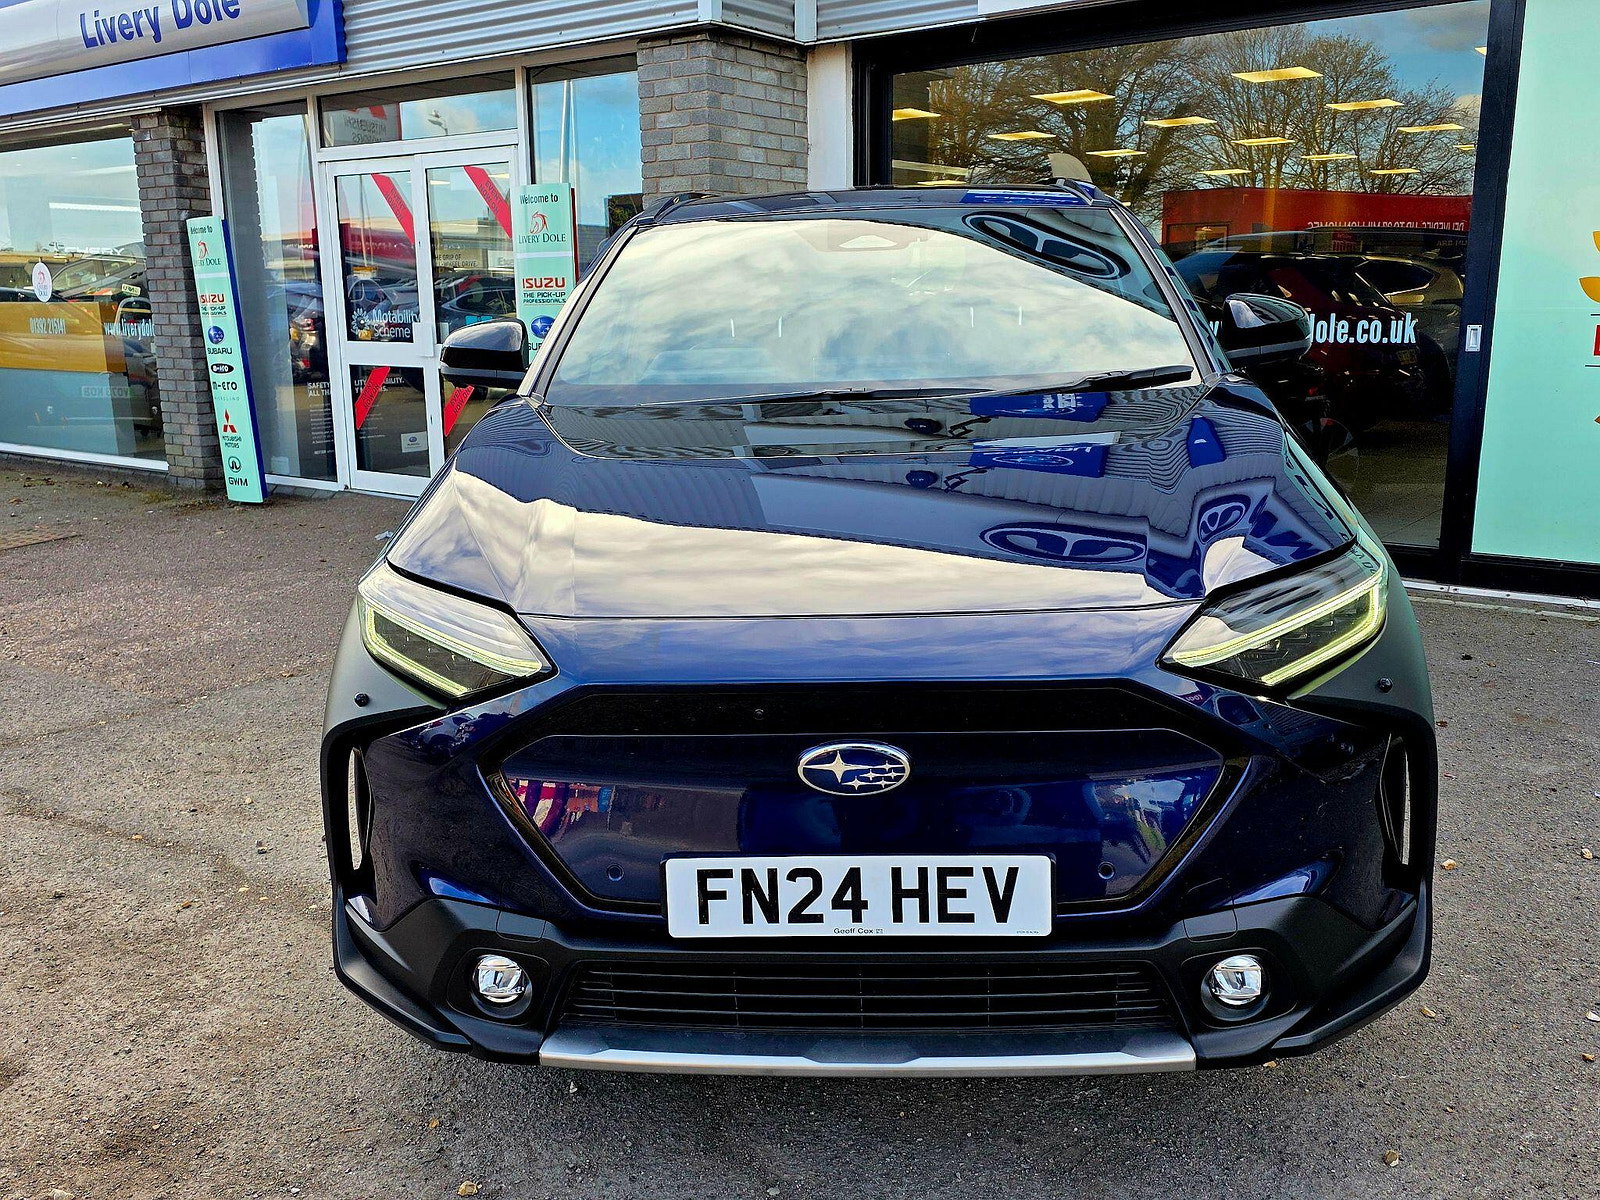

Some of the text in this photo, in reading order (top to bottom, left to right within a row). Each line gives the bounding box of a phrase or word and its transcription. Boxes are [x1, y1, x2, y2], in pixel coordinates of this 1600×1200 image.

[80, 0, 241, 48] Livery Dole
[520, 193, 559, 204] Welcome to
[519, 233, 567, 244] LIVERY DOLE
[522, 277, 566, 289] ISUZU
[200, 294, 225, 304] SUZU
[372, 310, 421, 324] Motability
[30, 318, 47, 334] 01392
[373, 324, 411, 338] Scheme
[1309, 312, 1418, 344] ole.co.uk
[228, 476, 248, 487] GWM
[696, 866, 1020, 925] FN24 HEV
